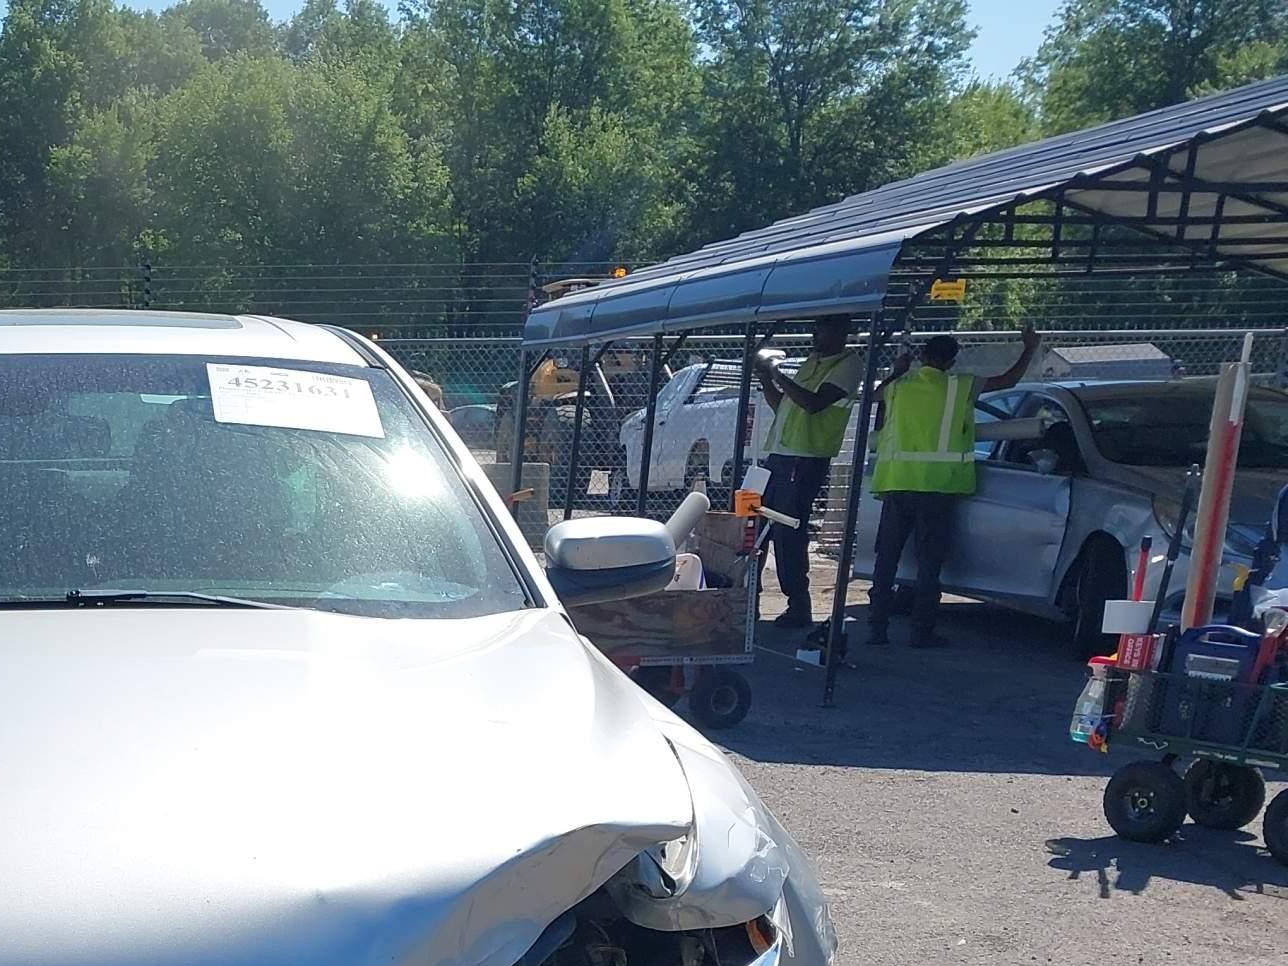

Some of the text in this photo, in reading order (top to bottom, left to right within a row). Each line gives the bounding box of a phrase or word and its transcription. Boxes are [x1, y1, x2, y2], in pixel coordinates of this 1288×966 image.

[227, 377, 350, 399] 45231631
[1123, 638, 1135, 664] OFFICE
[1133, 637, 1144, 658] KEYS
